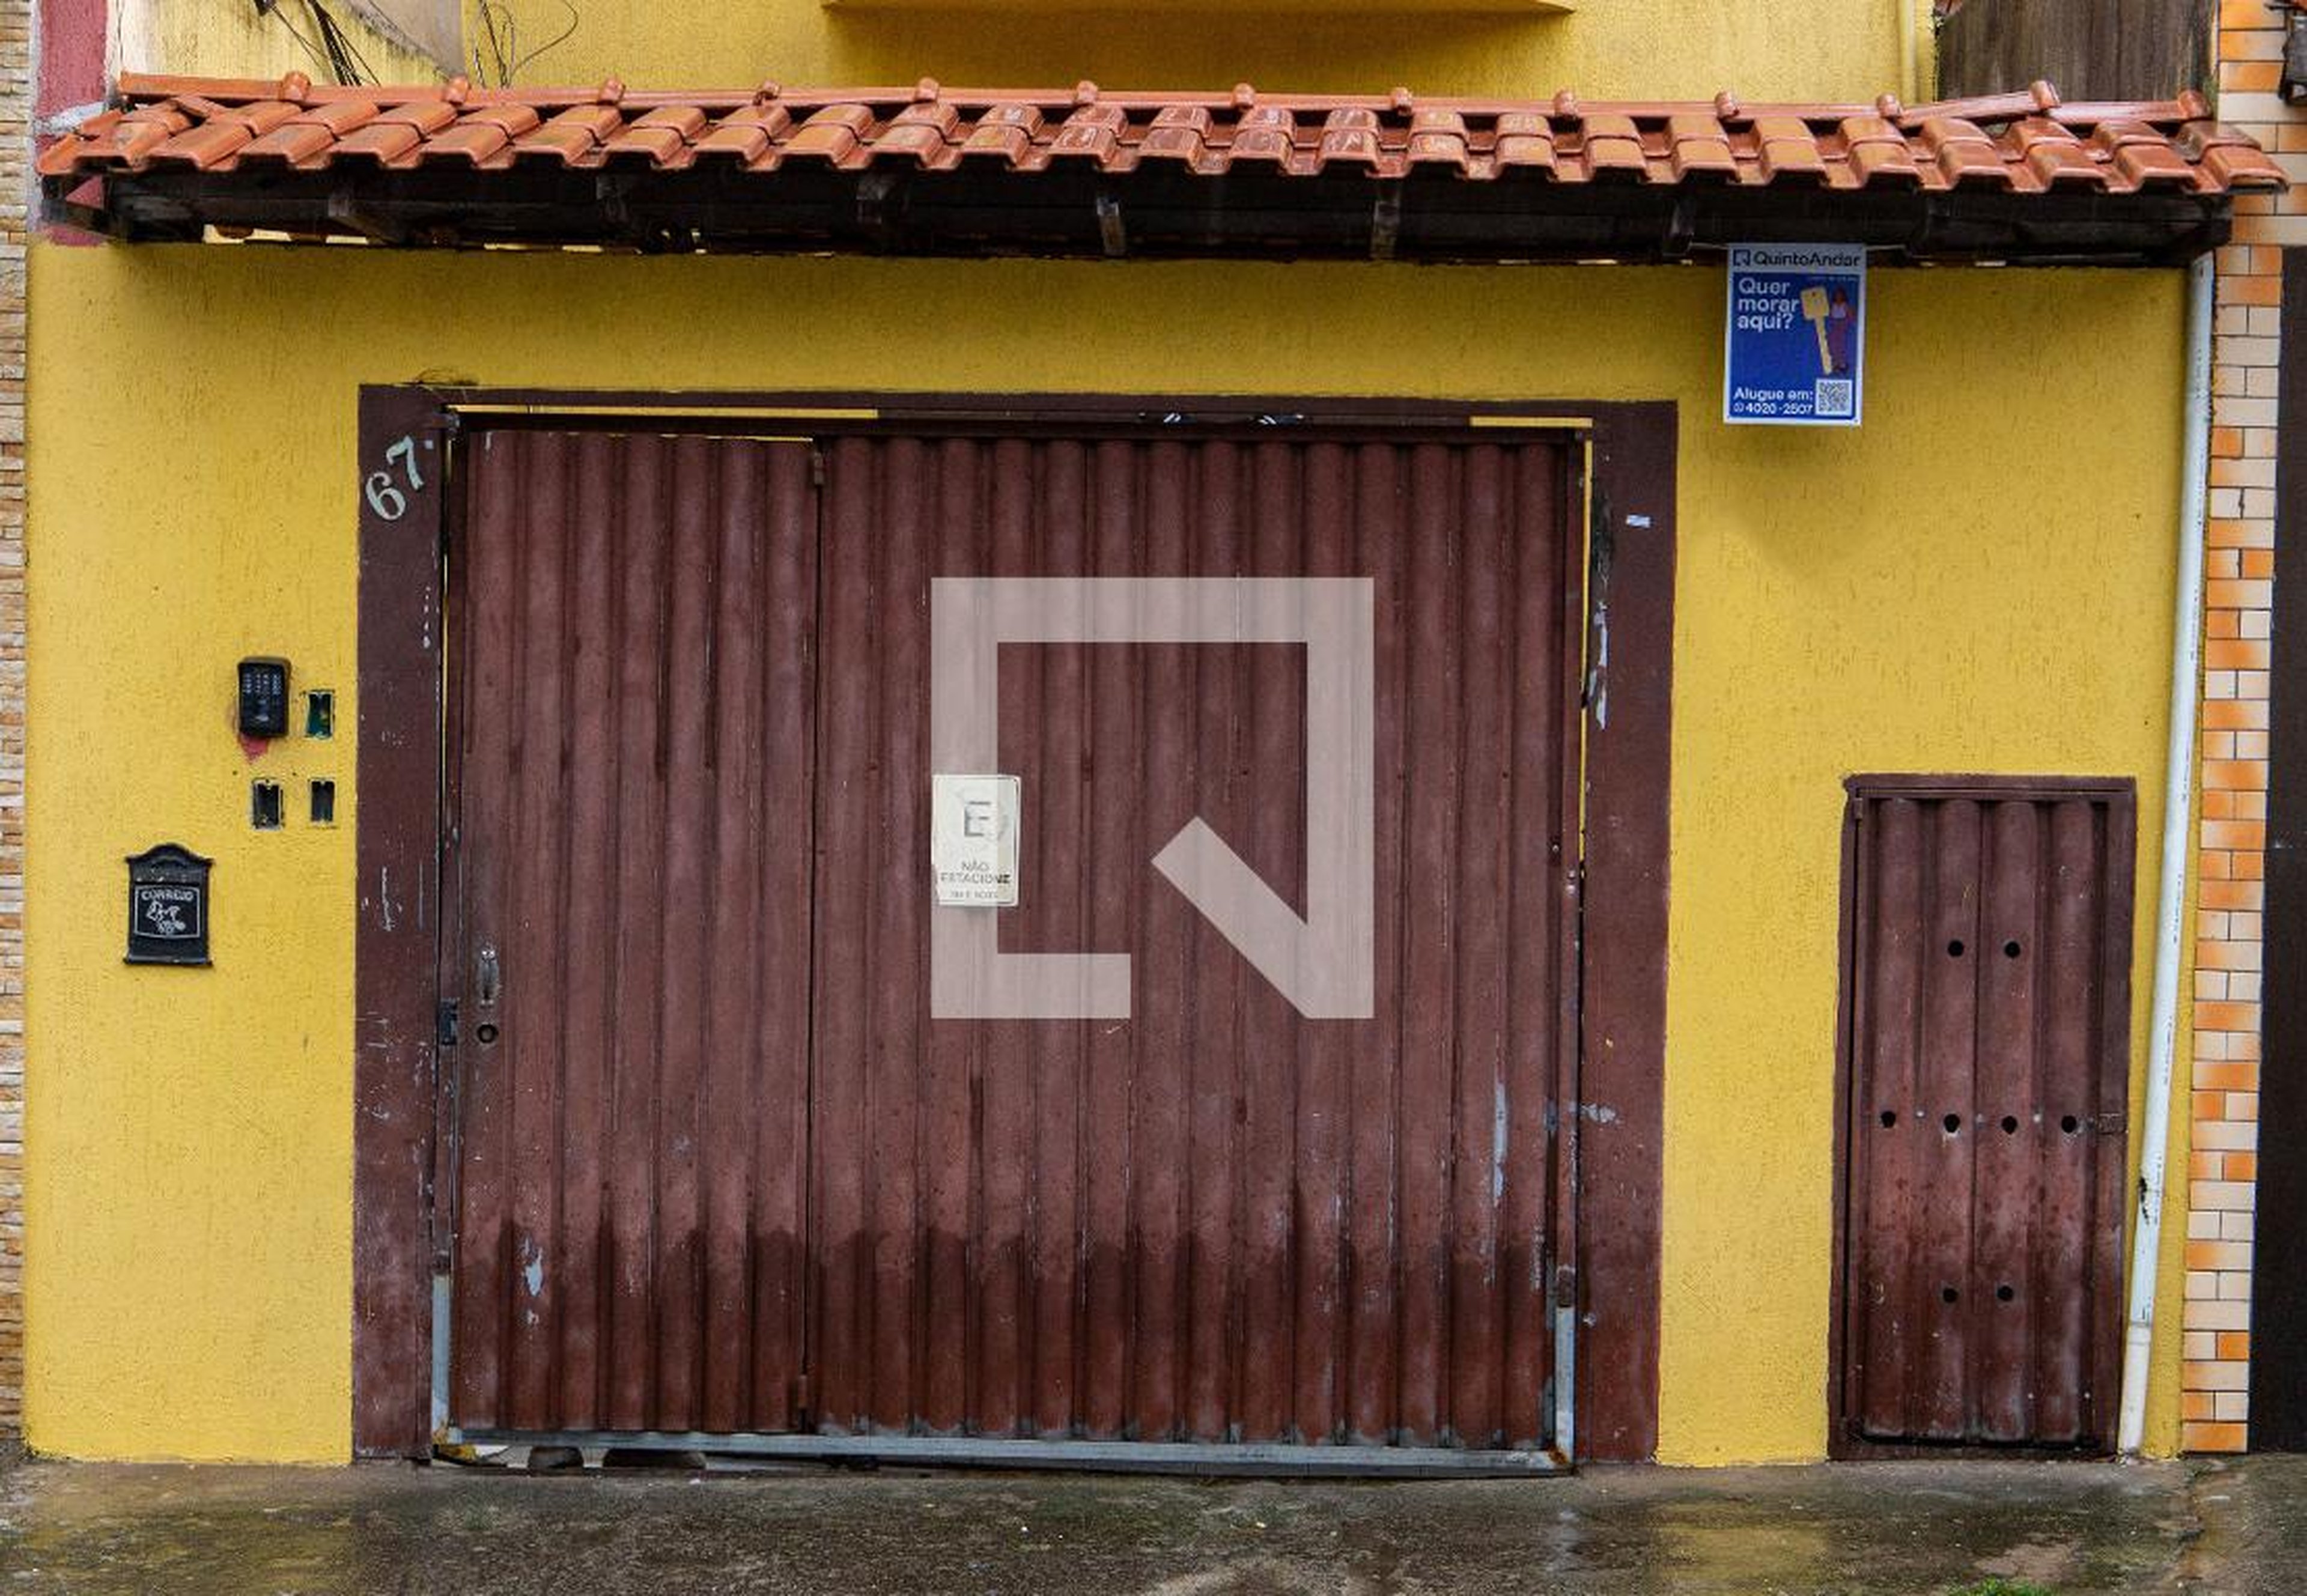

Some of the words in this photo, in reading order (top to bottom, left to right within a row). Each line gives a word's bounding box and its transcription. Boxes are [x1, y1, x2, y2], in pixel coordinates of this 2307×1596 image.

[1754, 250, 1860, 265] QuintoAndar
[1738, 277, 1790, 294] Quer
[1737, 298, 1799, 312] morar
[1737, 312, 1793, 332] aqui?
[1733, 386, 1784, 402] Alugue
[1787, 389, 1813, 401] em:
[365, 434, 424, 521] 67
